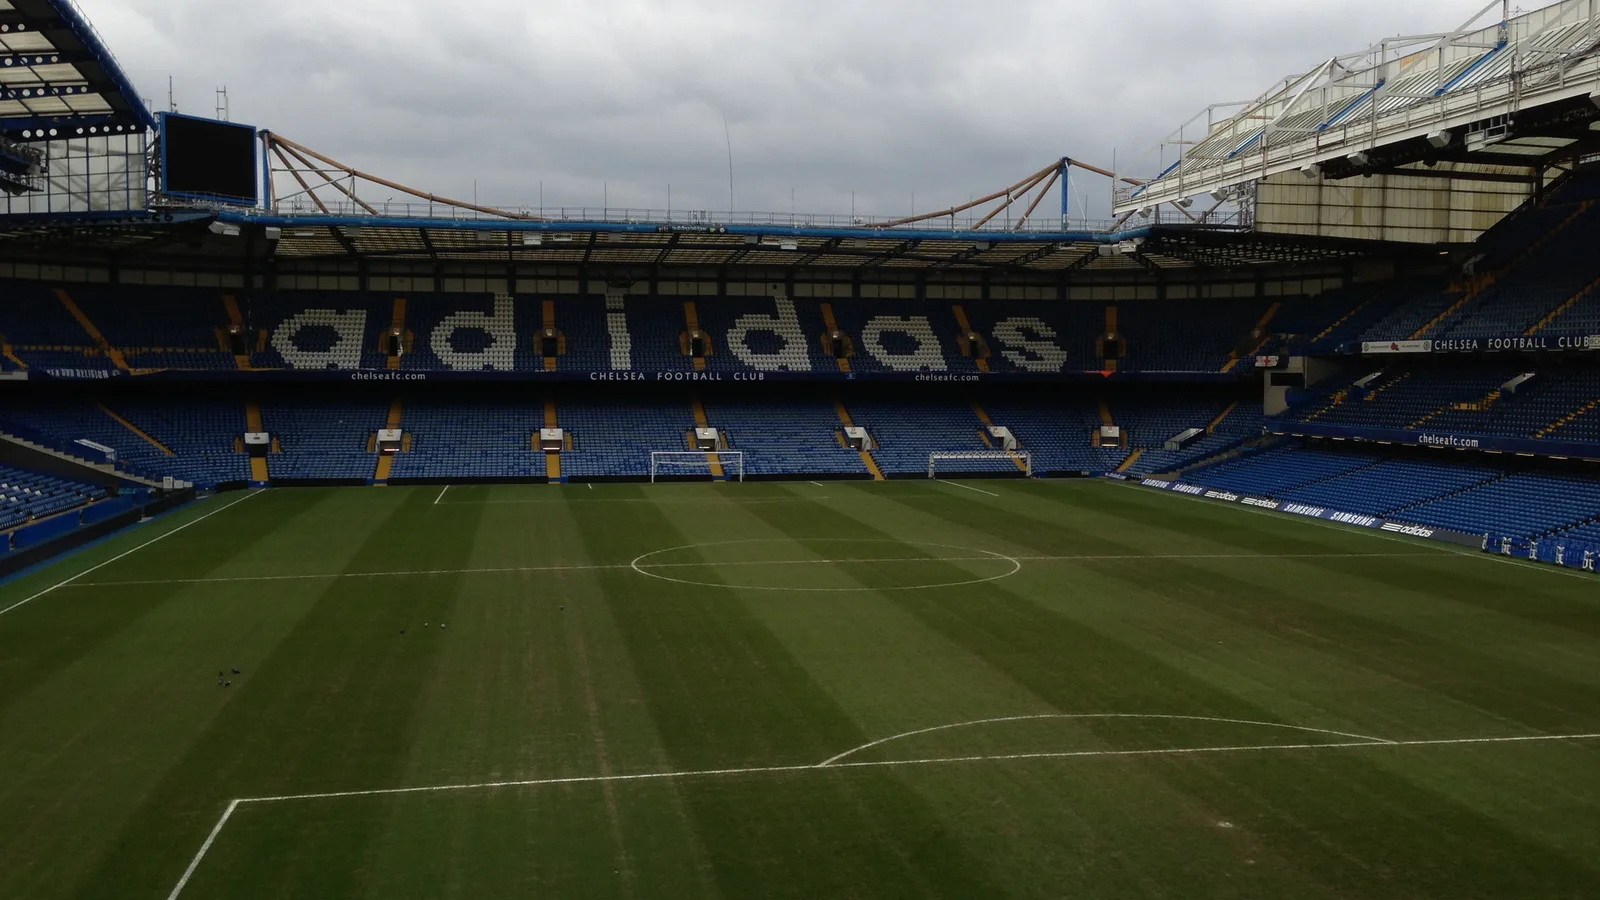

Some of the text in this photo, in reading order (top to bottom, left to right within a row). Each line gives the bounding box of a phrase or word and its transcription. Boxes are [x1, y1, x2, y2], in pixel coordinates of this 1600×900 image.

[270, 292, 1069, 371] adidas
[1434, 339, 1478, 350] CHELSEA
[1488, 337, 1547, 349] FOOTBALL
[1558, 336, 1589, 348] CLUB
[351, 371, 426, 380] chelseafc.com
[590, 371, 765, 381] CHELSEA FOOTBALL CLUB
[915, 373, 979, 381] chelseafc.com
[1418, 432, 1479, 448] chelseafc.com
[1141, 478, 1170, 489] SAMSUNG
[1172, 483, 1203, 495] SAMSUNG
[1216, 491, 1238, 502] adidas
[1254, 496, 1279, 509] adidas
[1283, 503, 1325, 517] SAMSUNG
[1330, 511, 1376, 527] SAMSUNG
[1399, 524, 1434, 538] adidas
